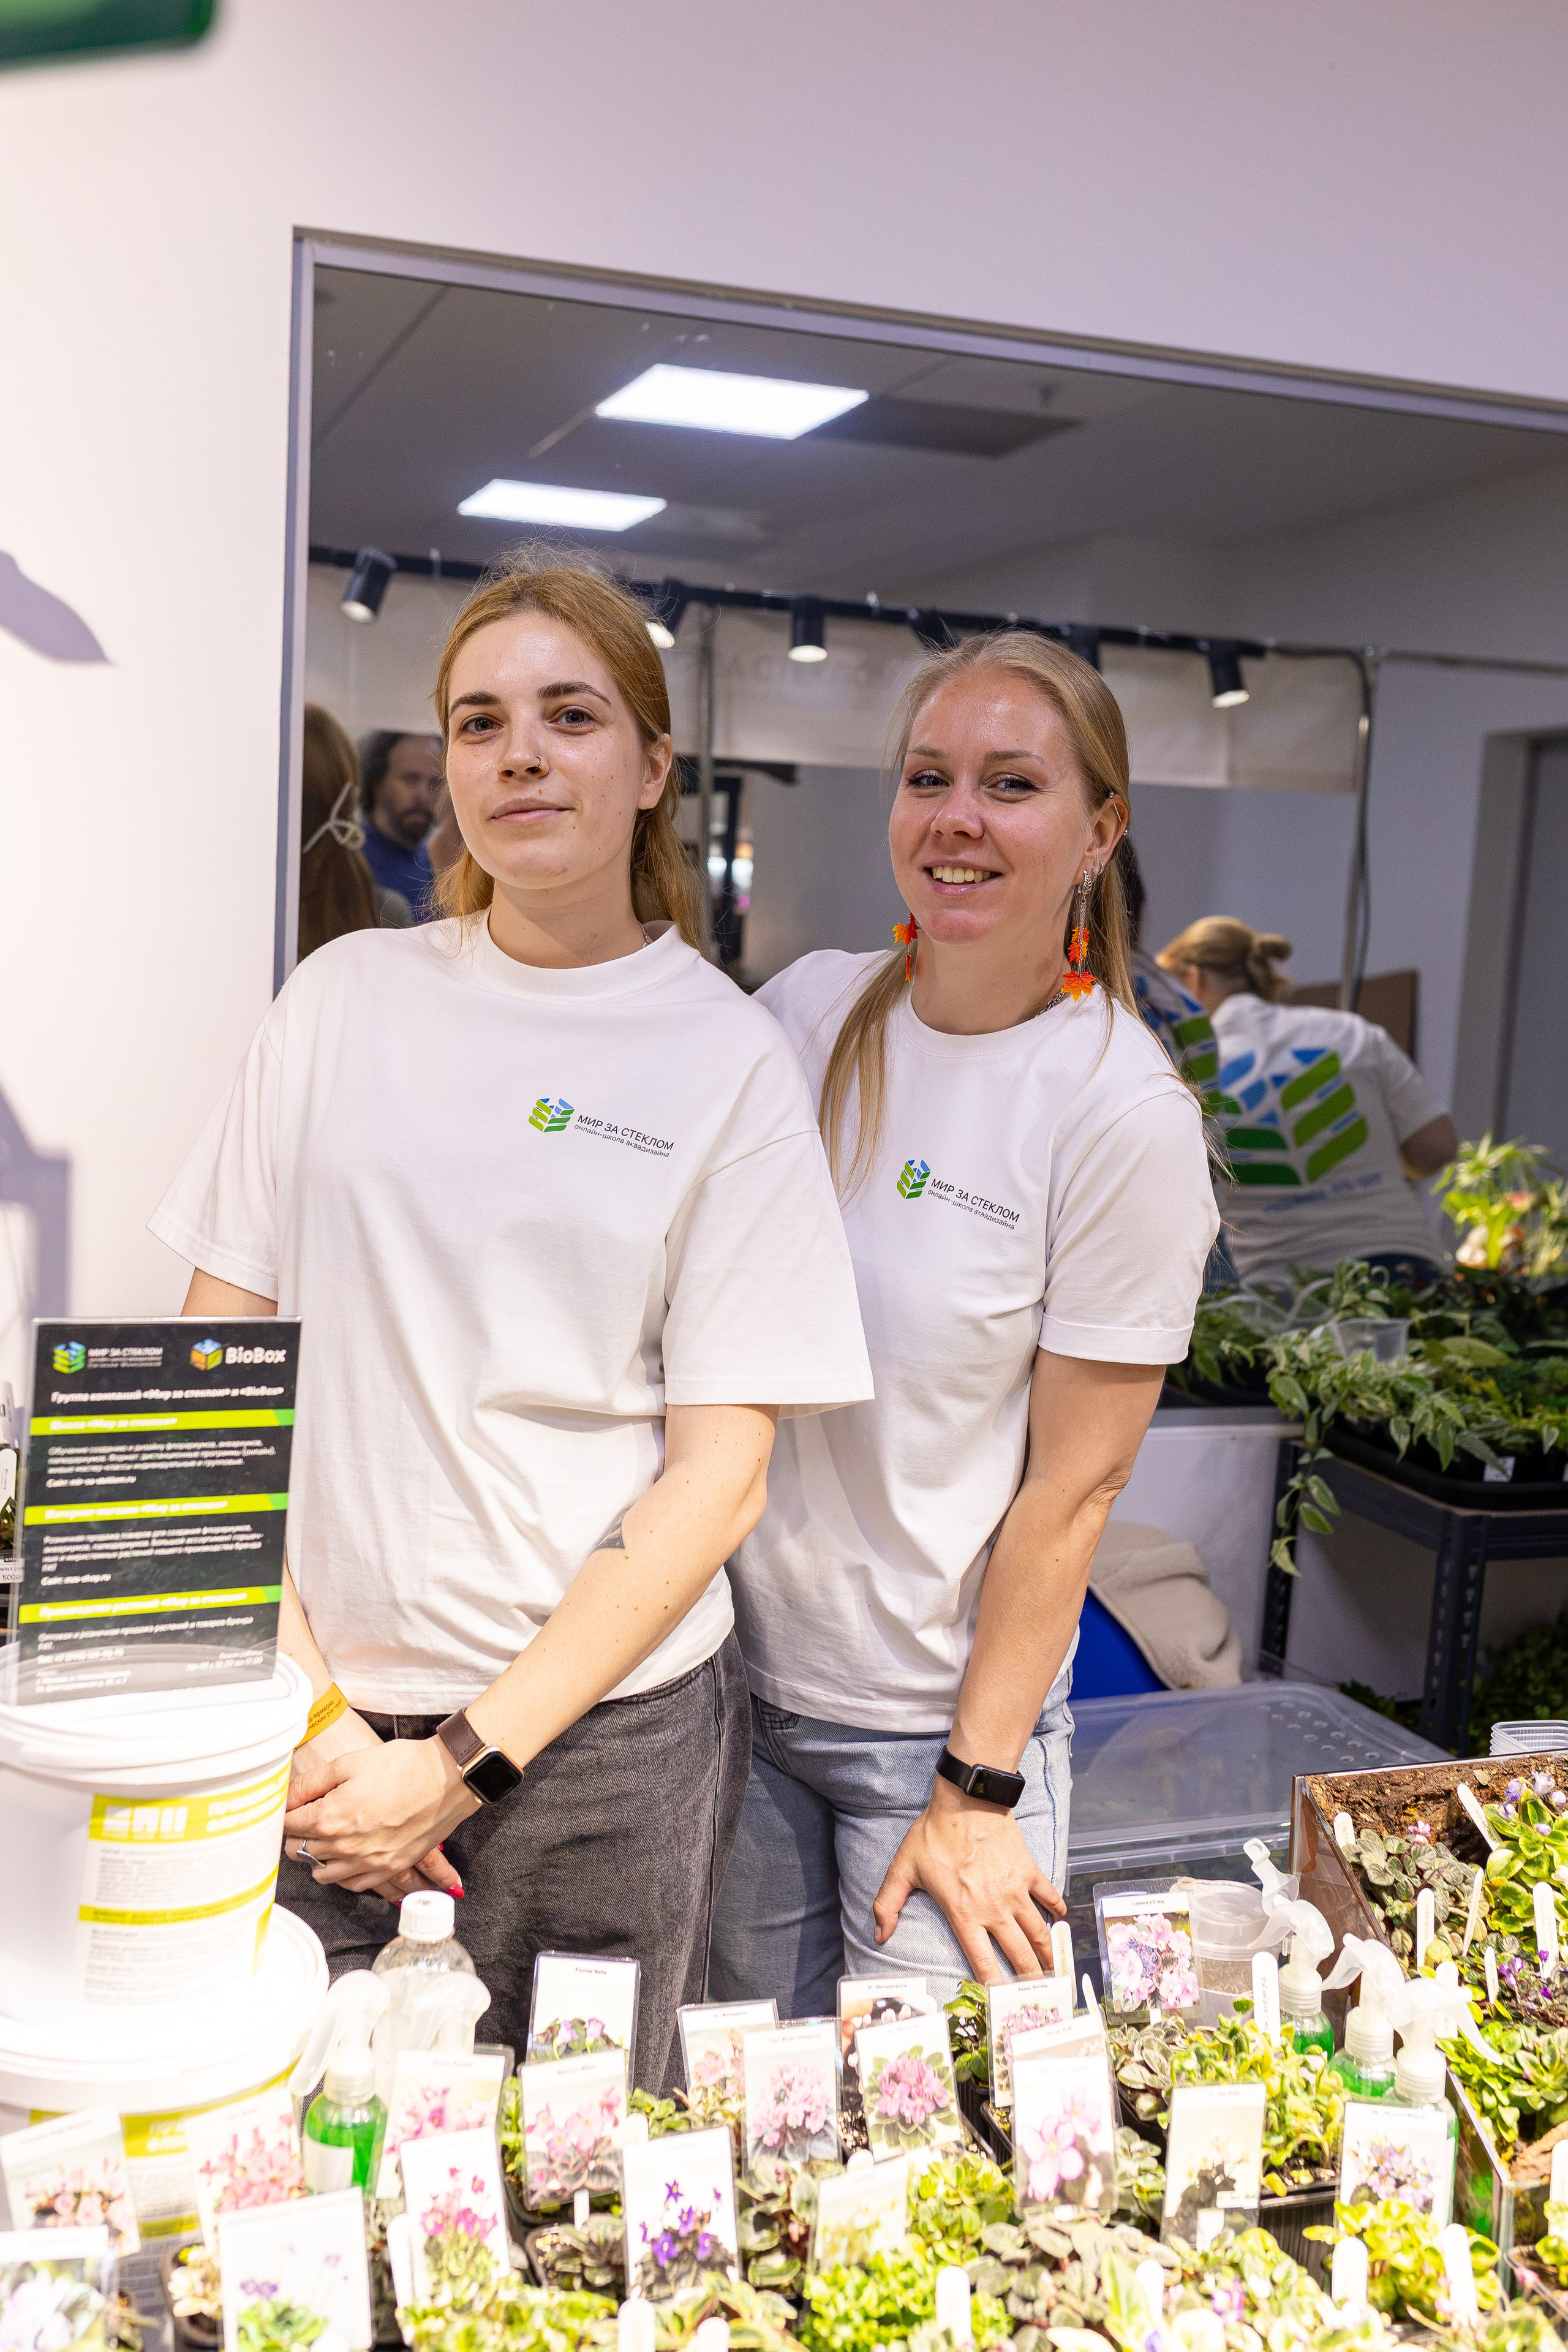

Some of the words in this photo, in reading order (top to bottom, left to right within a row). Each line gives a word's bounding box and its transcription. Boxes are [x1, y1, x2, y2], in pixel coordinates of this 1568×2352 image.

[574, 1124, 625, 1144] онлайн-школа
[625, 1139, 669, 1158] аквадизайна
[577, 1115, 603, 1128] МИР
[604, 1123, 619, 1134] ЗА
[621, 1128, 674, 1151] СТЕКЛОМ
[928, 1189, 973, 1213] онлайн-школа
[974, 1209, 1015, 1230] аквадизайна
[931, 1178, 955, 1193] МИР
[956, 1189, 968, 1202] ЗА
[971, 1196, 1020, 1223] СТЕКЛОМ
[225, 1346, 287, 1364] BioBox
[308, 1700, 334, 1723] а-ярмарка
